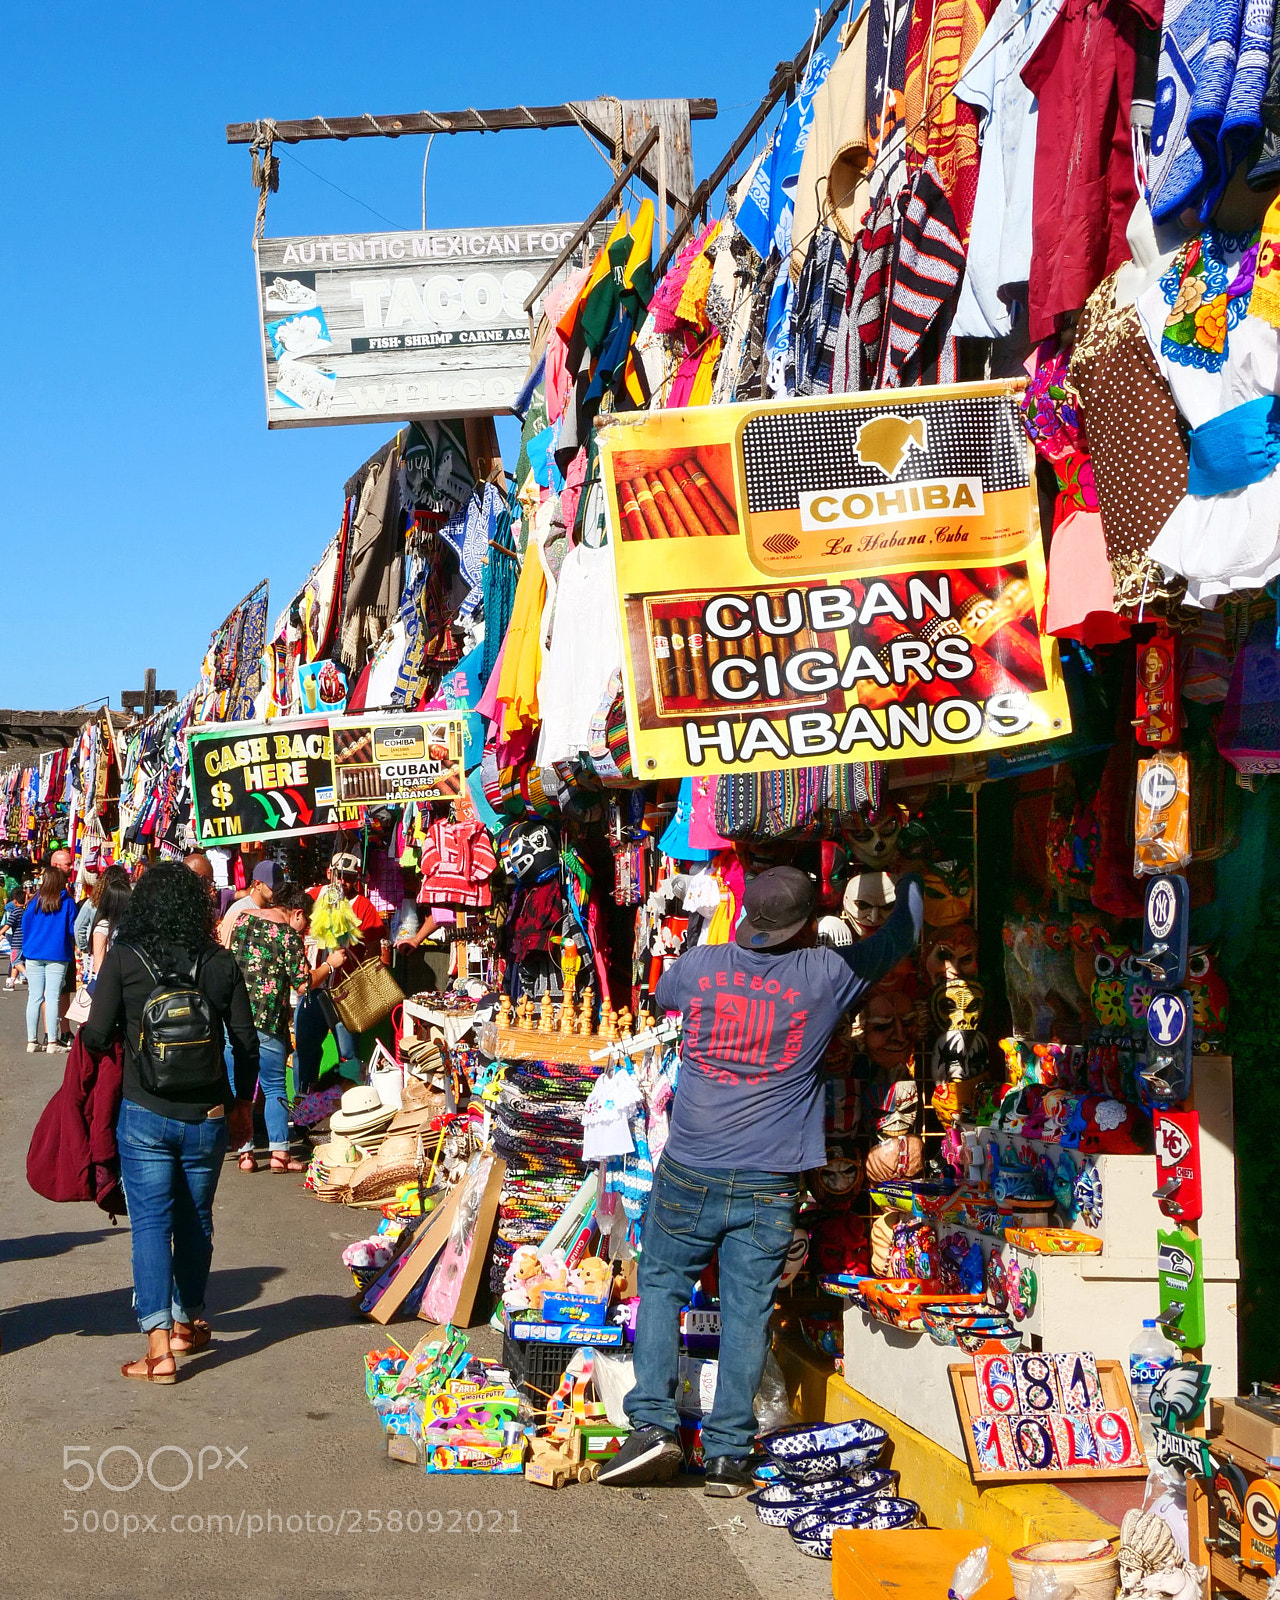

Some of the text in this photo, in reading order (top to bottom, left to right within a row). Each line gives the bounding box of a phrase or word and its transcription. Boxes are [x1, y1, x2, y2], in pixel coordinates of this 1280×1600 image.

[282, 238, 406, 265] AUTENTIC
[411, 233, 521, 258] MEXICAN
[350, 270, 541, 329] TACOS
[404, 332, 453, 348] SHRIMP
[458, 329, 504, 344] CARNE
[810, 483, 977, 523] COHIBA
[820, 536, 853, 557] La
[704, 576, 953, 640] CUBAN
[710, 637, 975, 701] CIGARS
[684, 692, 1033, 767] HABANOS
[384, 738, 415, 747] COHIBA
[205, 736, 270, 778] CASH
[243, 760, 309, 793] HERE
[385, 763, 440, 777] CUBAN
[385, 788, 441, 801] HABANOS
[391, 777, 434, 788] CIGARS
[210, 780, 234, 811] $
[318, 792, 333, 800] VISA
[327, 805, 360, 824] ATM
[202, 815, 242, 839] ATM
[698, 970, 802, 1006] REEBOK
[687, 997, 703, 1049] UNITED
[773, 1009, 809, 1073] AMERICA
[569, 1239, 585, 1264] Guitar
[450, 1381, 477, 1394] FARTS
[485, 1389, 505, 1399] PUTTY
[458, 1448, 486, 1461] FARTS
[1156, 1427, 1205, 1472] EAGLES
[1218, 1519, 1241, 1538] BRONCOS
